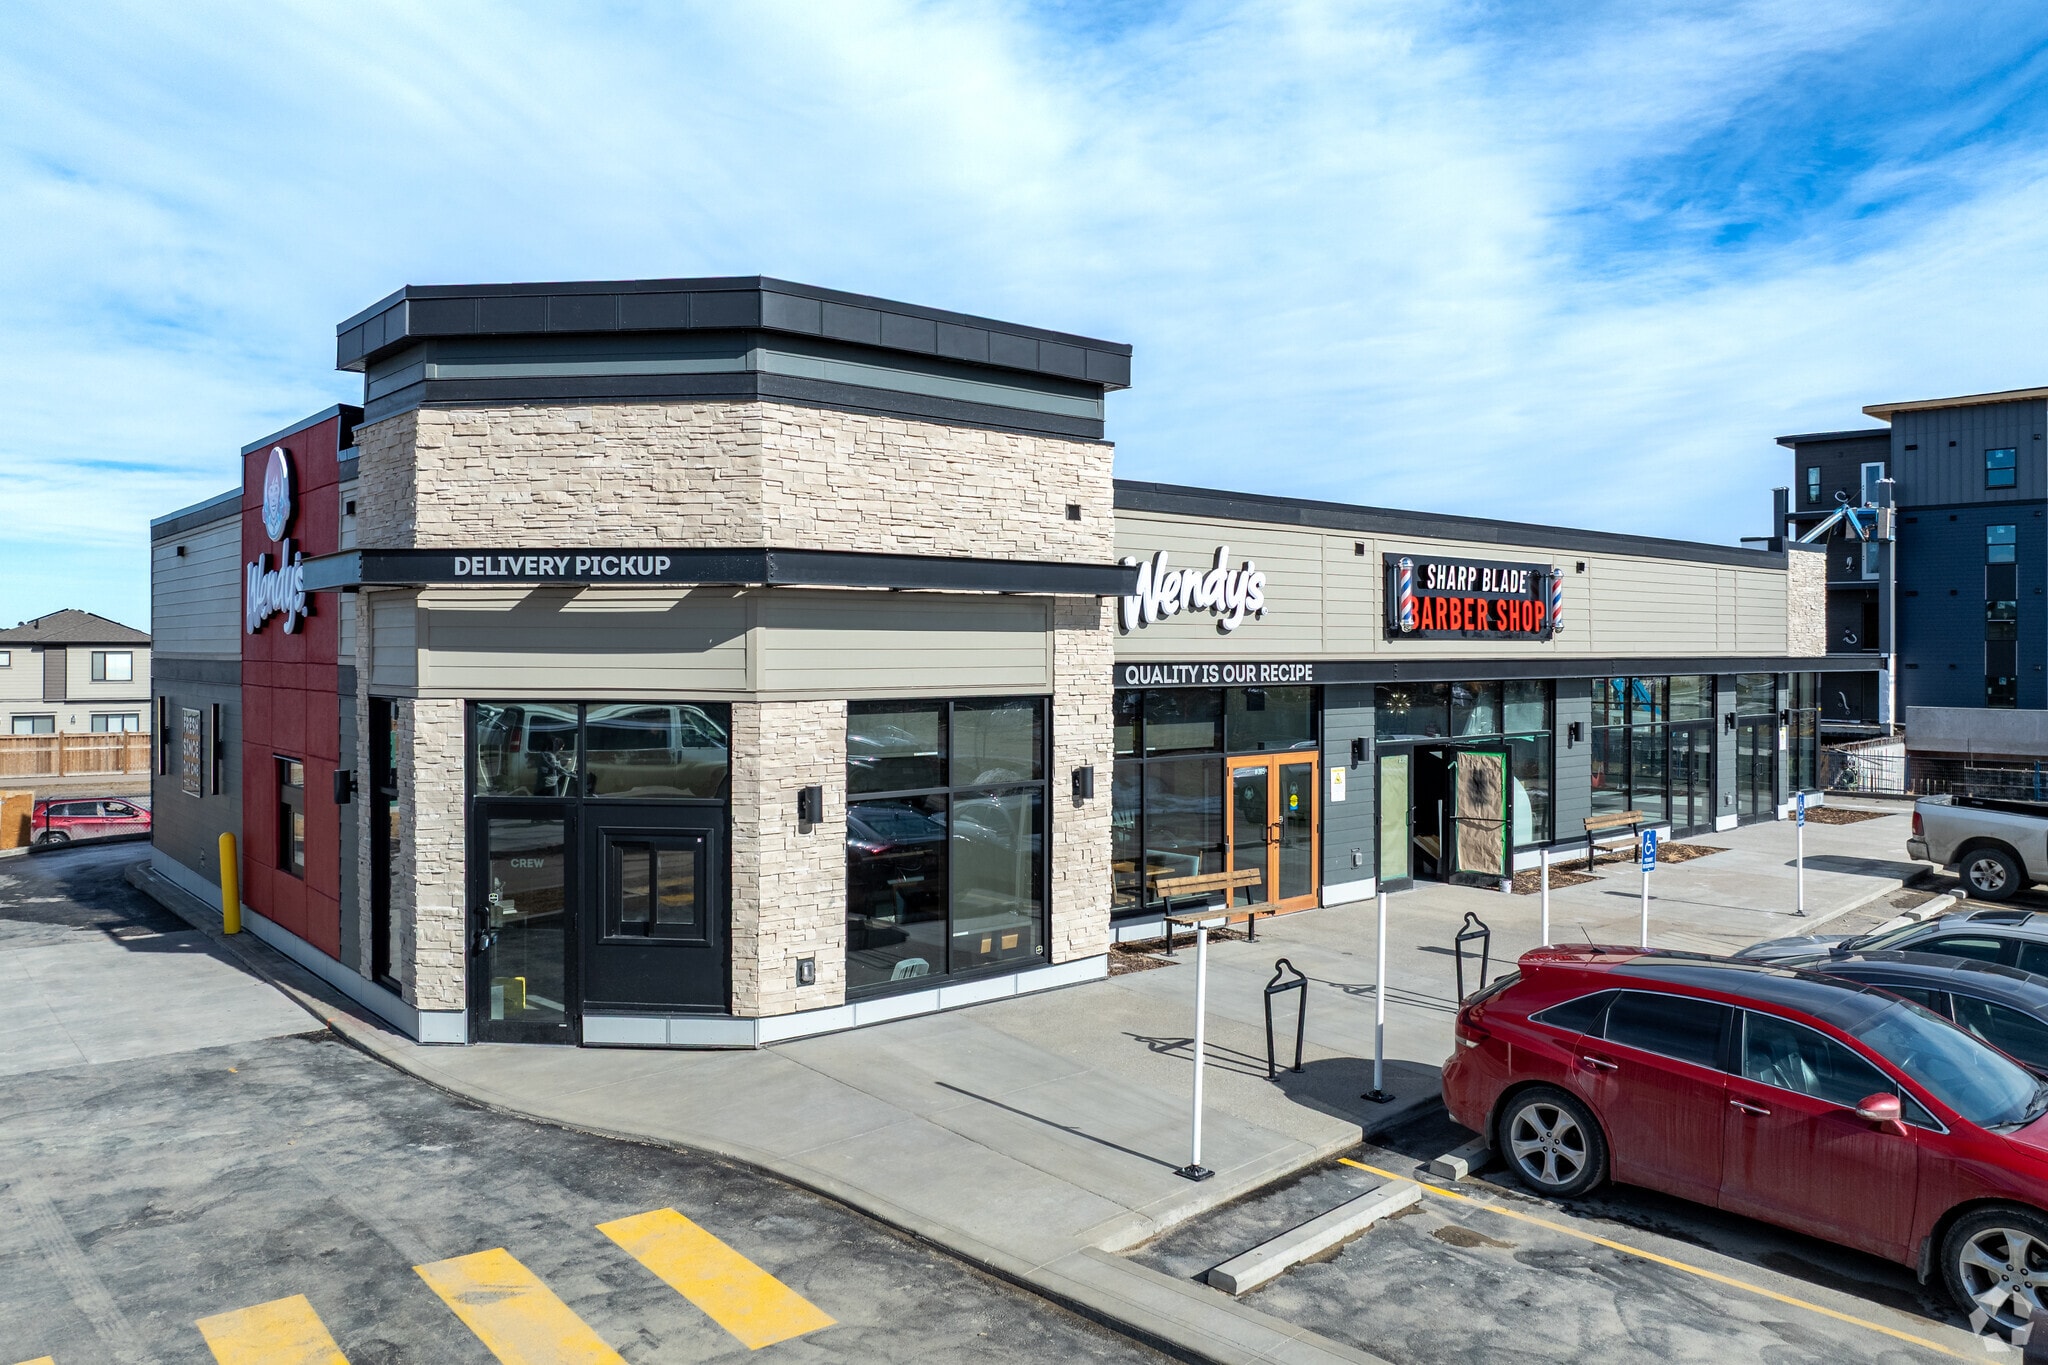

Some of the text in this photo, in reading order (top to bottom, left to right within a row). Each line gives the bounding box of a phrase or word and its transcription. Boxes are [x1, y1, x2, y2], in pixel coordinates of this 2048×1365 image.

[454, 556, 671, 576] DELIVERY PICKUP
[1427, 563, 1527, 594] SHARP BLADE
[246, 537, 305, 634] Wendy's
[1124, 545, 1266, 631] Wendy's
[1411, 595, 1546, 632] BARBER SHOP
[1125, 664, 1313, 685] QUALITY IS OUR RECIPE
[510, 858, 545, 869] CREW
